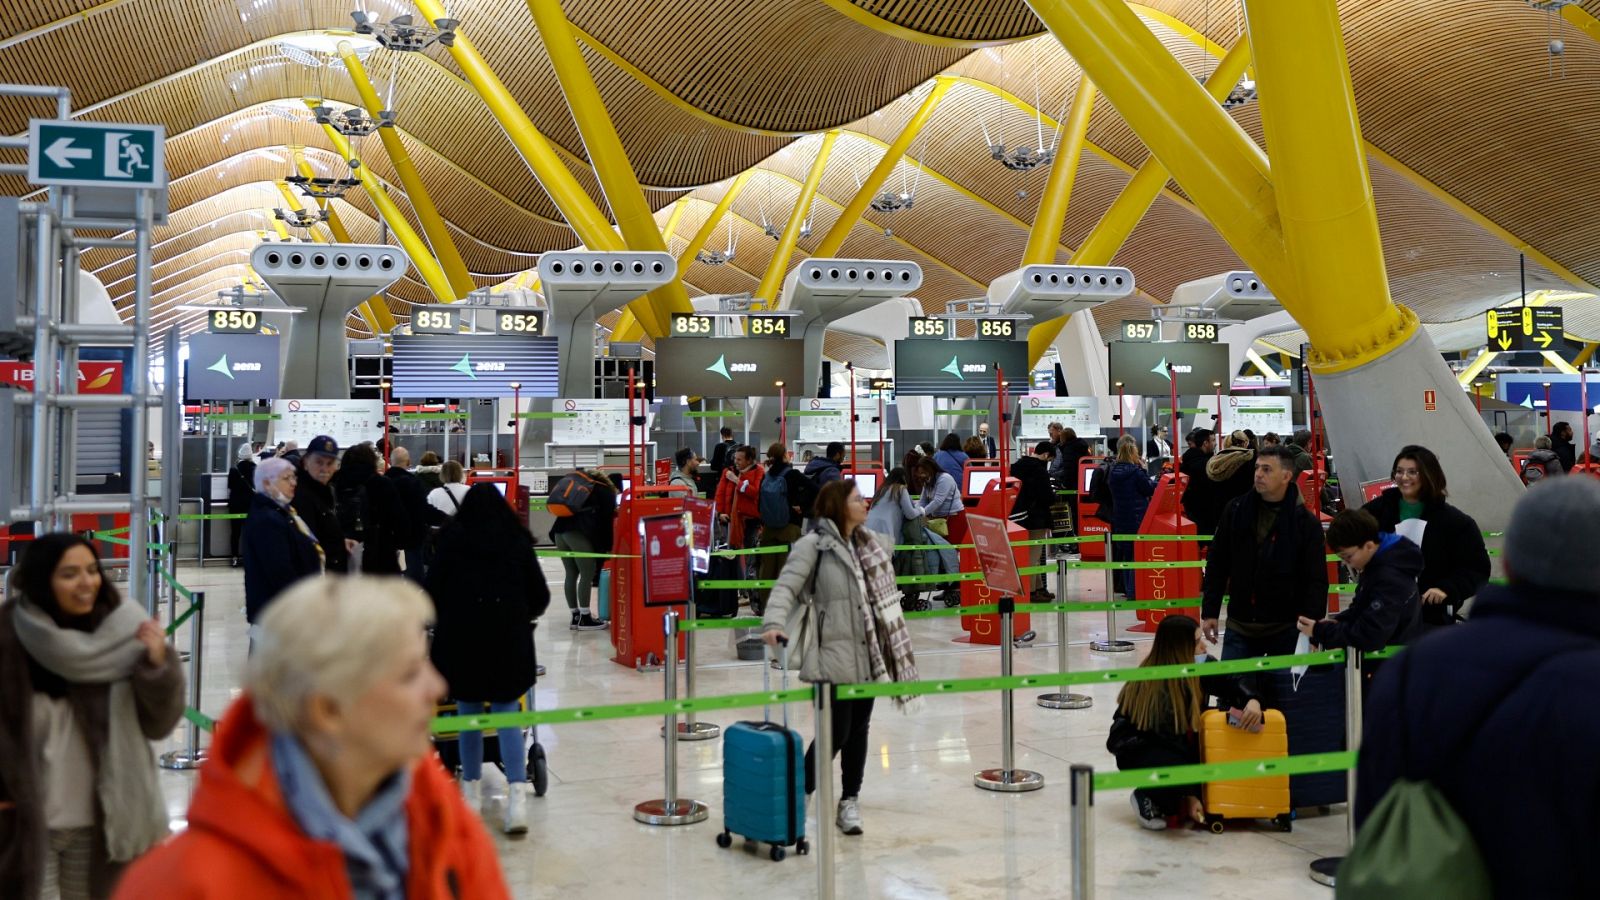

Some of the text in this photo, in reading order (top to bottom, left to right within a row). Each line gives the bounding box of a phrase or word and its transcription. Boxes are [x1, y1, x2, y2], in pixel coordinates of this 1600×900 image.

[213, 311, 257, 329] 850
[416, 310, 453, 329] 851
[500, 314, 538, 332] 852
[676, 316, 711, 333] 853
[752, 318, 786, 335] 854
[914, 319, 945, 335] 855
[982, 321, 1012, 336] 856
[1127, 323, 1154, 338] 857
[1188, 324, 1215, 339] 858
[232, 362, 262, 371] aena
[475, 361, 506, 371] aena
[730, 362, 757, 372] aena
[963, 364, 987, 373] aena
[13, 369, 86, 381] IBA
